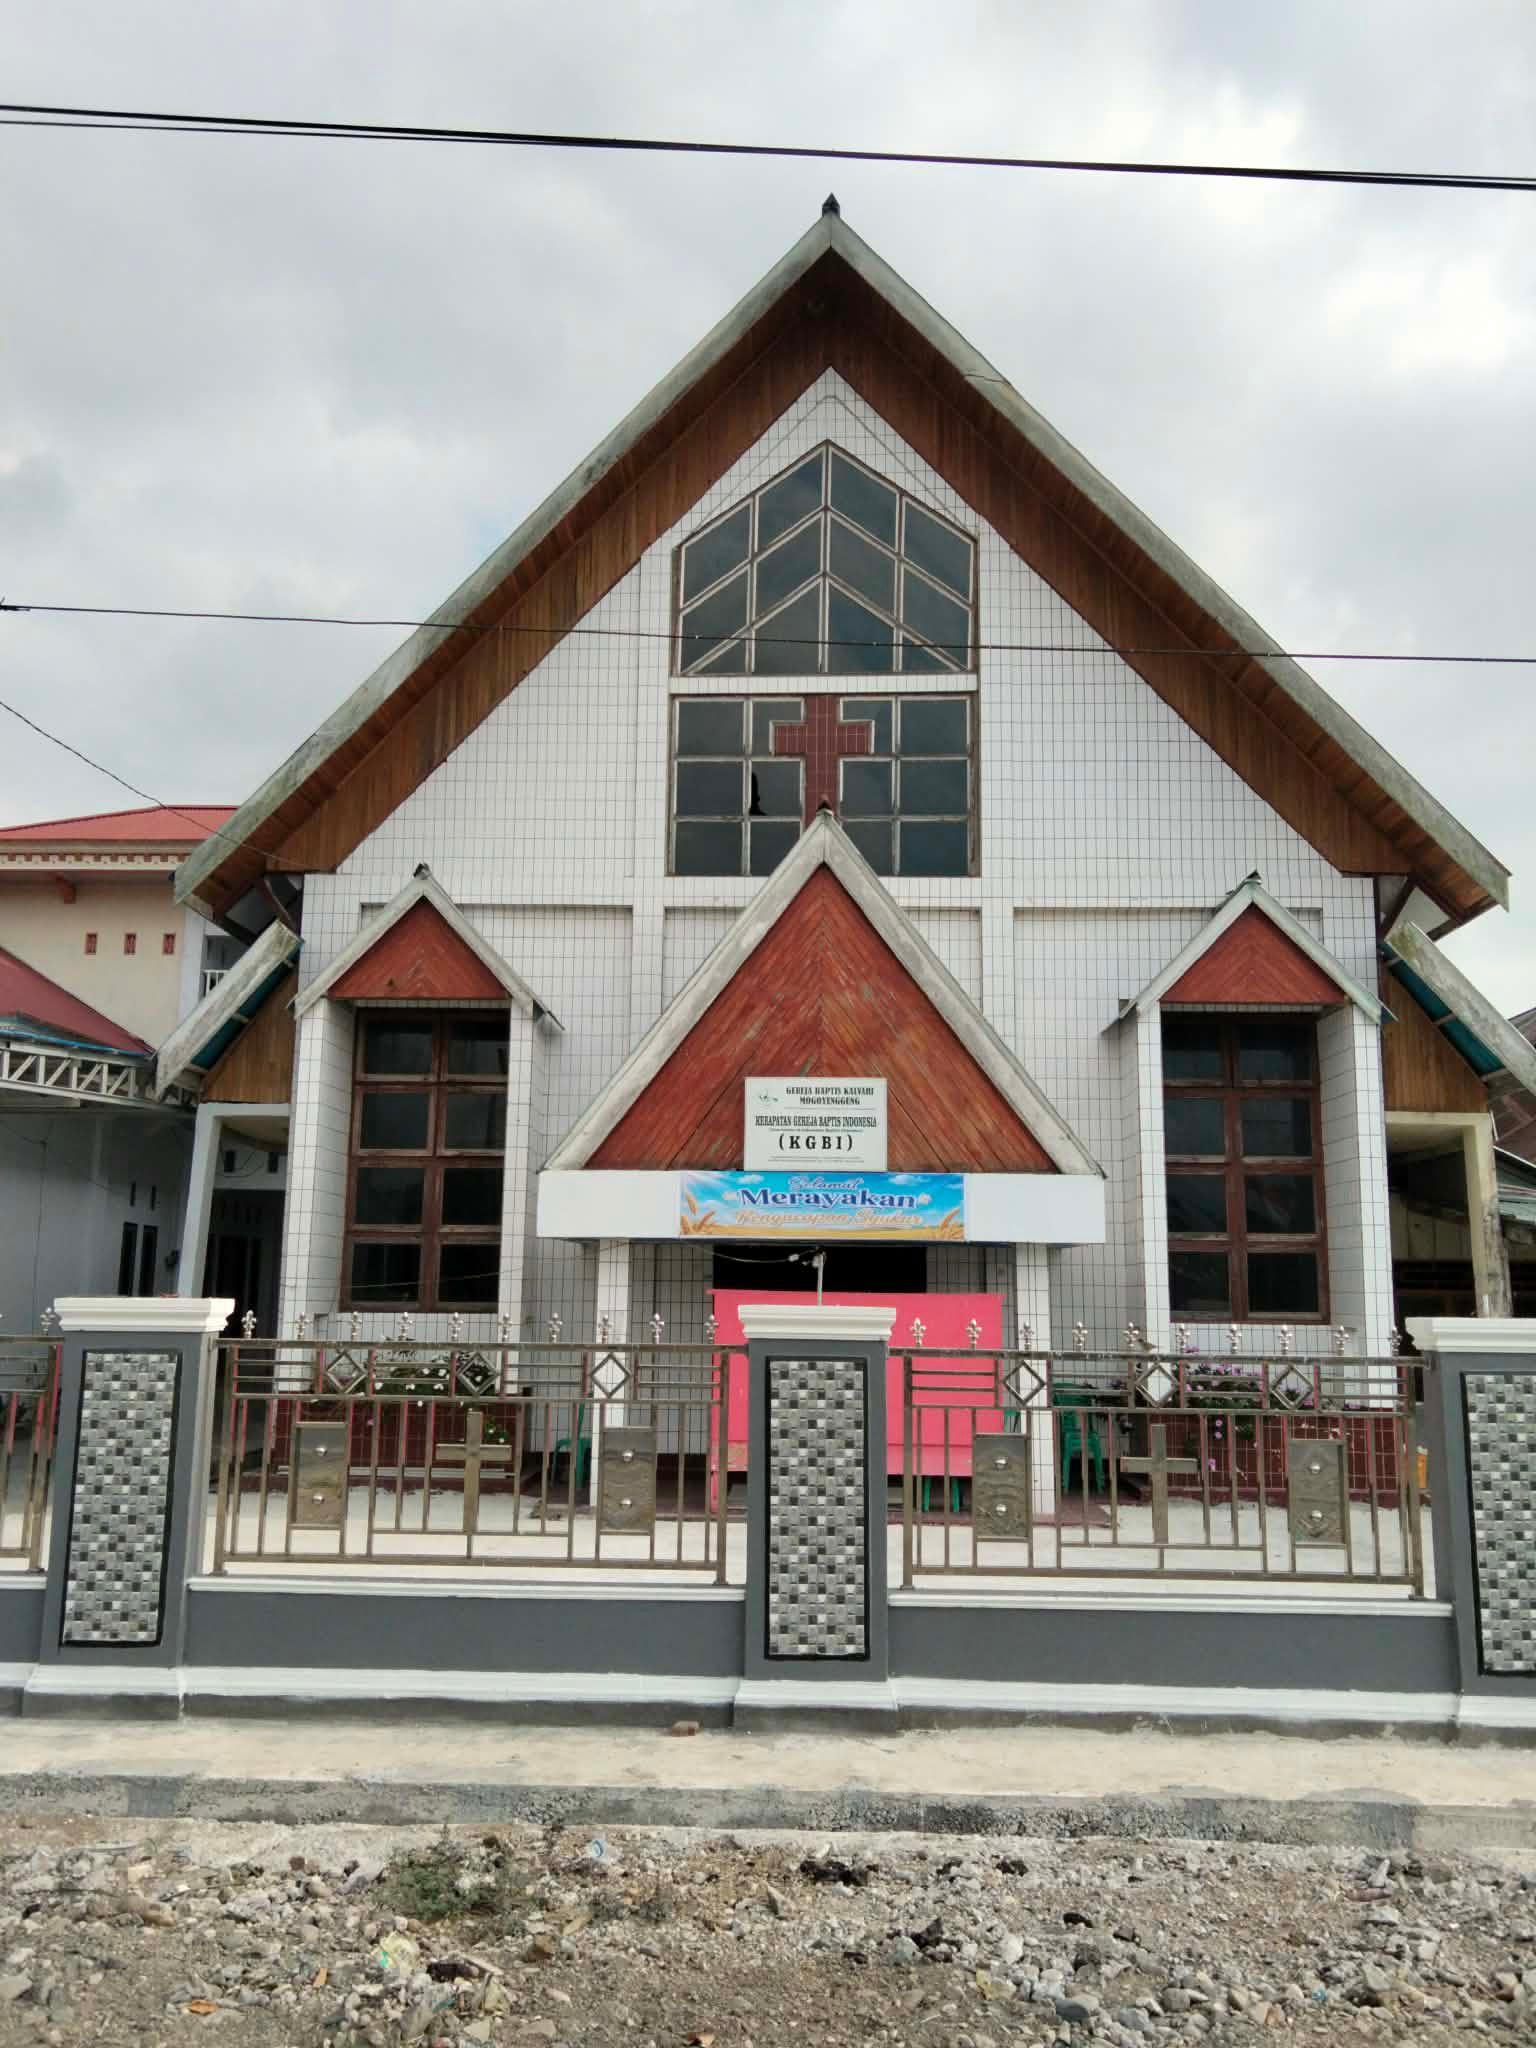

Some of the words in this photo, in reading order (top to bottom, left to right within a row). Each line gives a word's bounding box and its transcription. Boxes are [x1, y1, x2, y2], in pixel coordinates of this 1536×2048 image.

[815, 1087, 842, 1095] BAPTIS
[844, 1087, 874, 1096] KALVARI
[755, 1115, 792, 1126] KERAPATAN
[793, 1116, 818, 1127] GEREJA
[819, 1116, 841, 1127] BAPTIS
[842, 1116, 877, 1128] INDONESIA
[788, 1176, 864, 1191] Selamat
[740, 1188, 916, 1208] Merayakan
